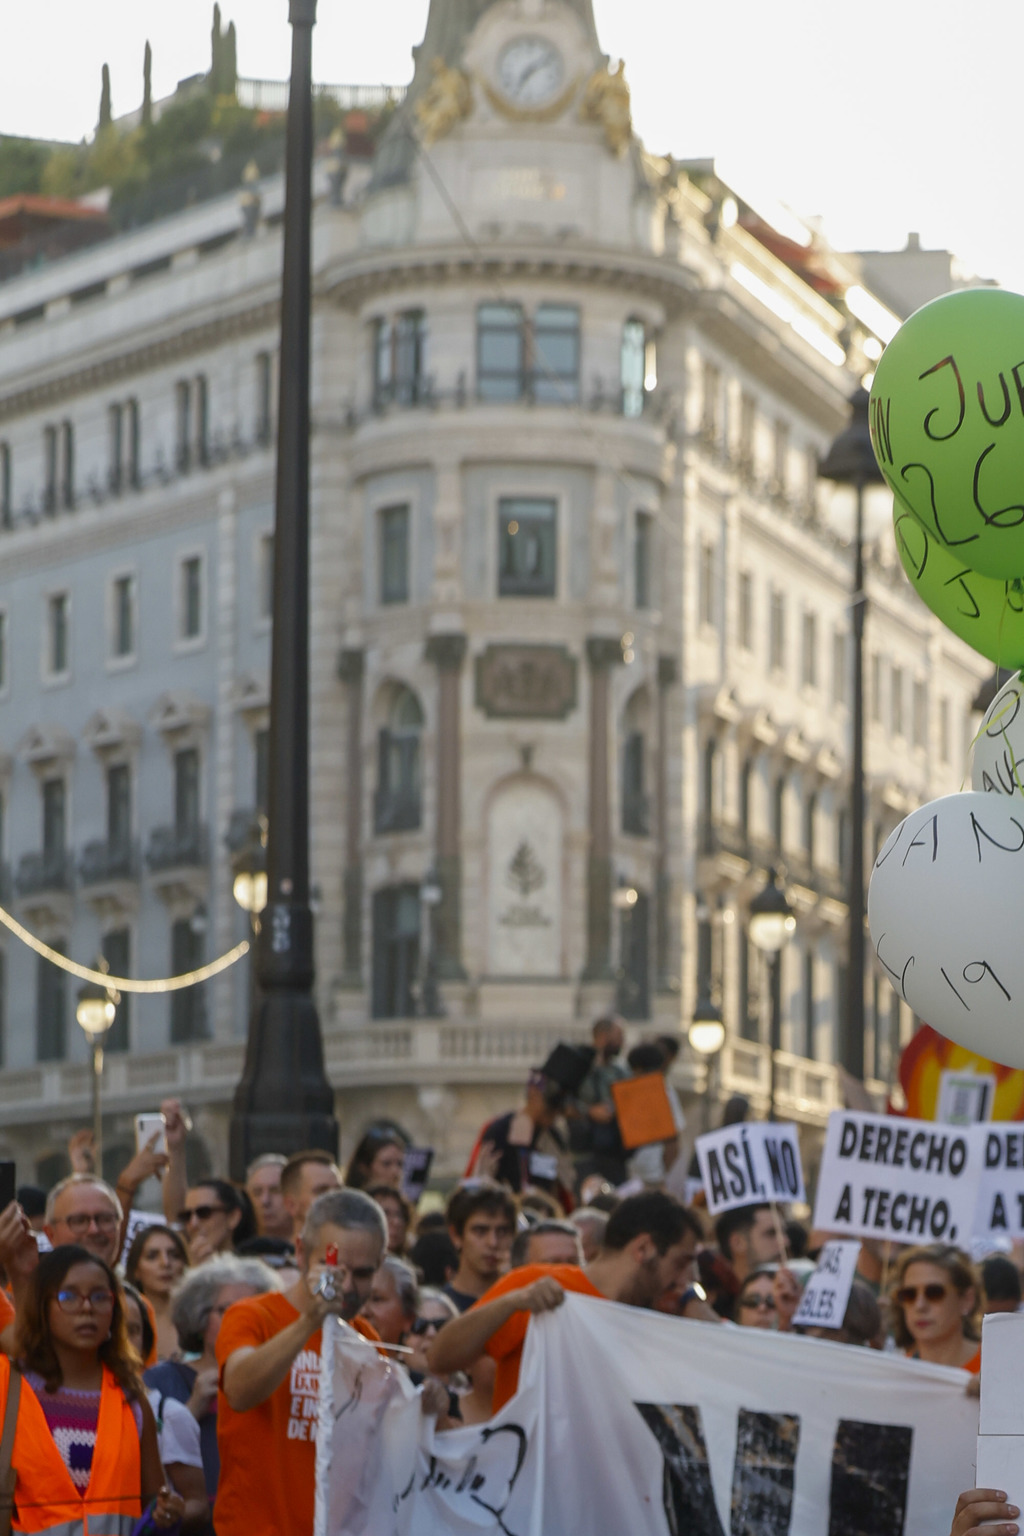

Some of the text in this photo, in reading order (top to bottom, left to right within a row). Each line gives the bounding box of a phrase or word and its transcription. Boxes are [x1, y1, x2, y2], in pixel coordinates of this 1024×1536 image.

[764, 1137, 799, 1196] NO
[839, 1120, 968, 1177] DERECHO
[834, 1182, 957, 1240] A TECHO.
[990, 1194, 1008, 1230] A
